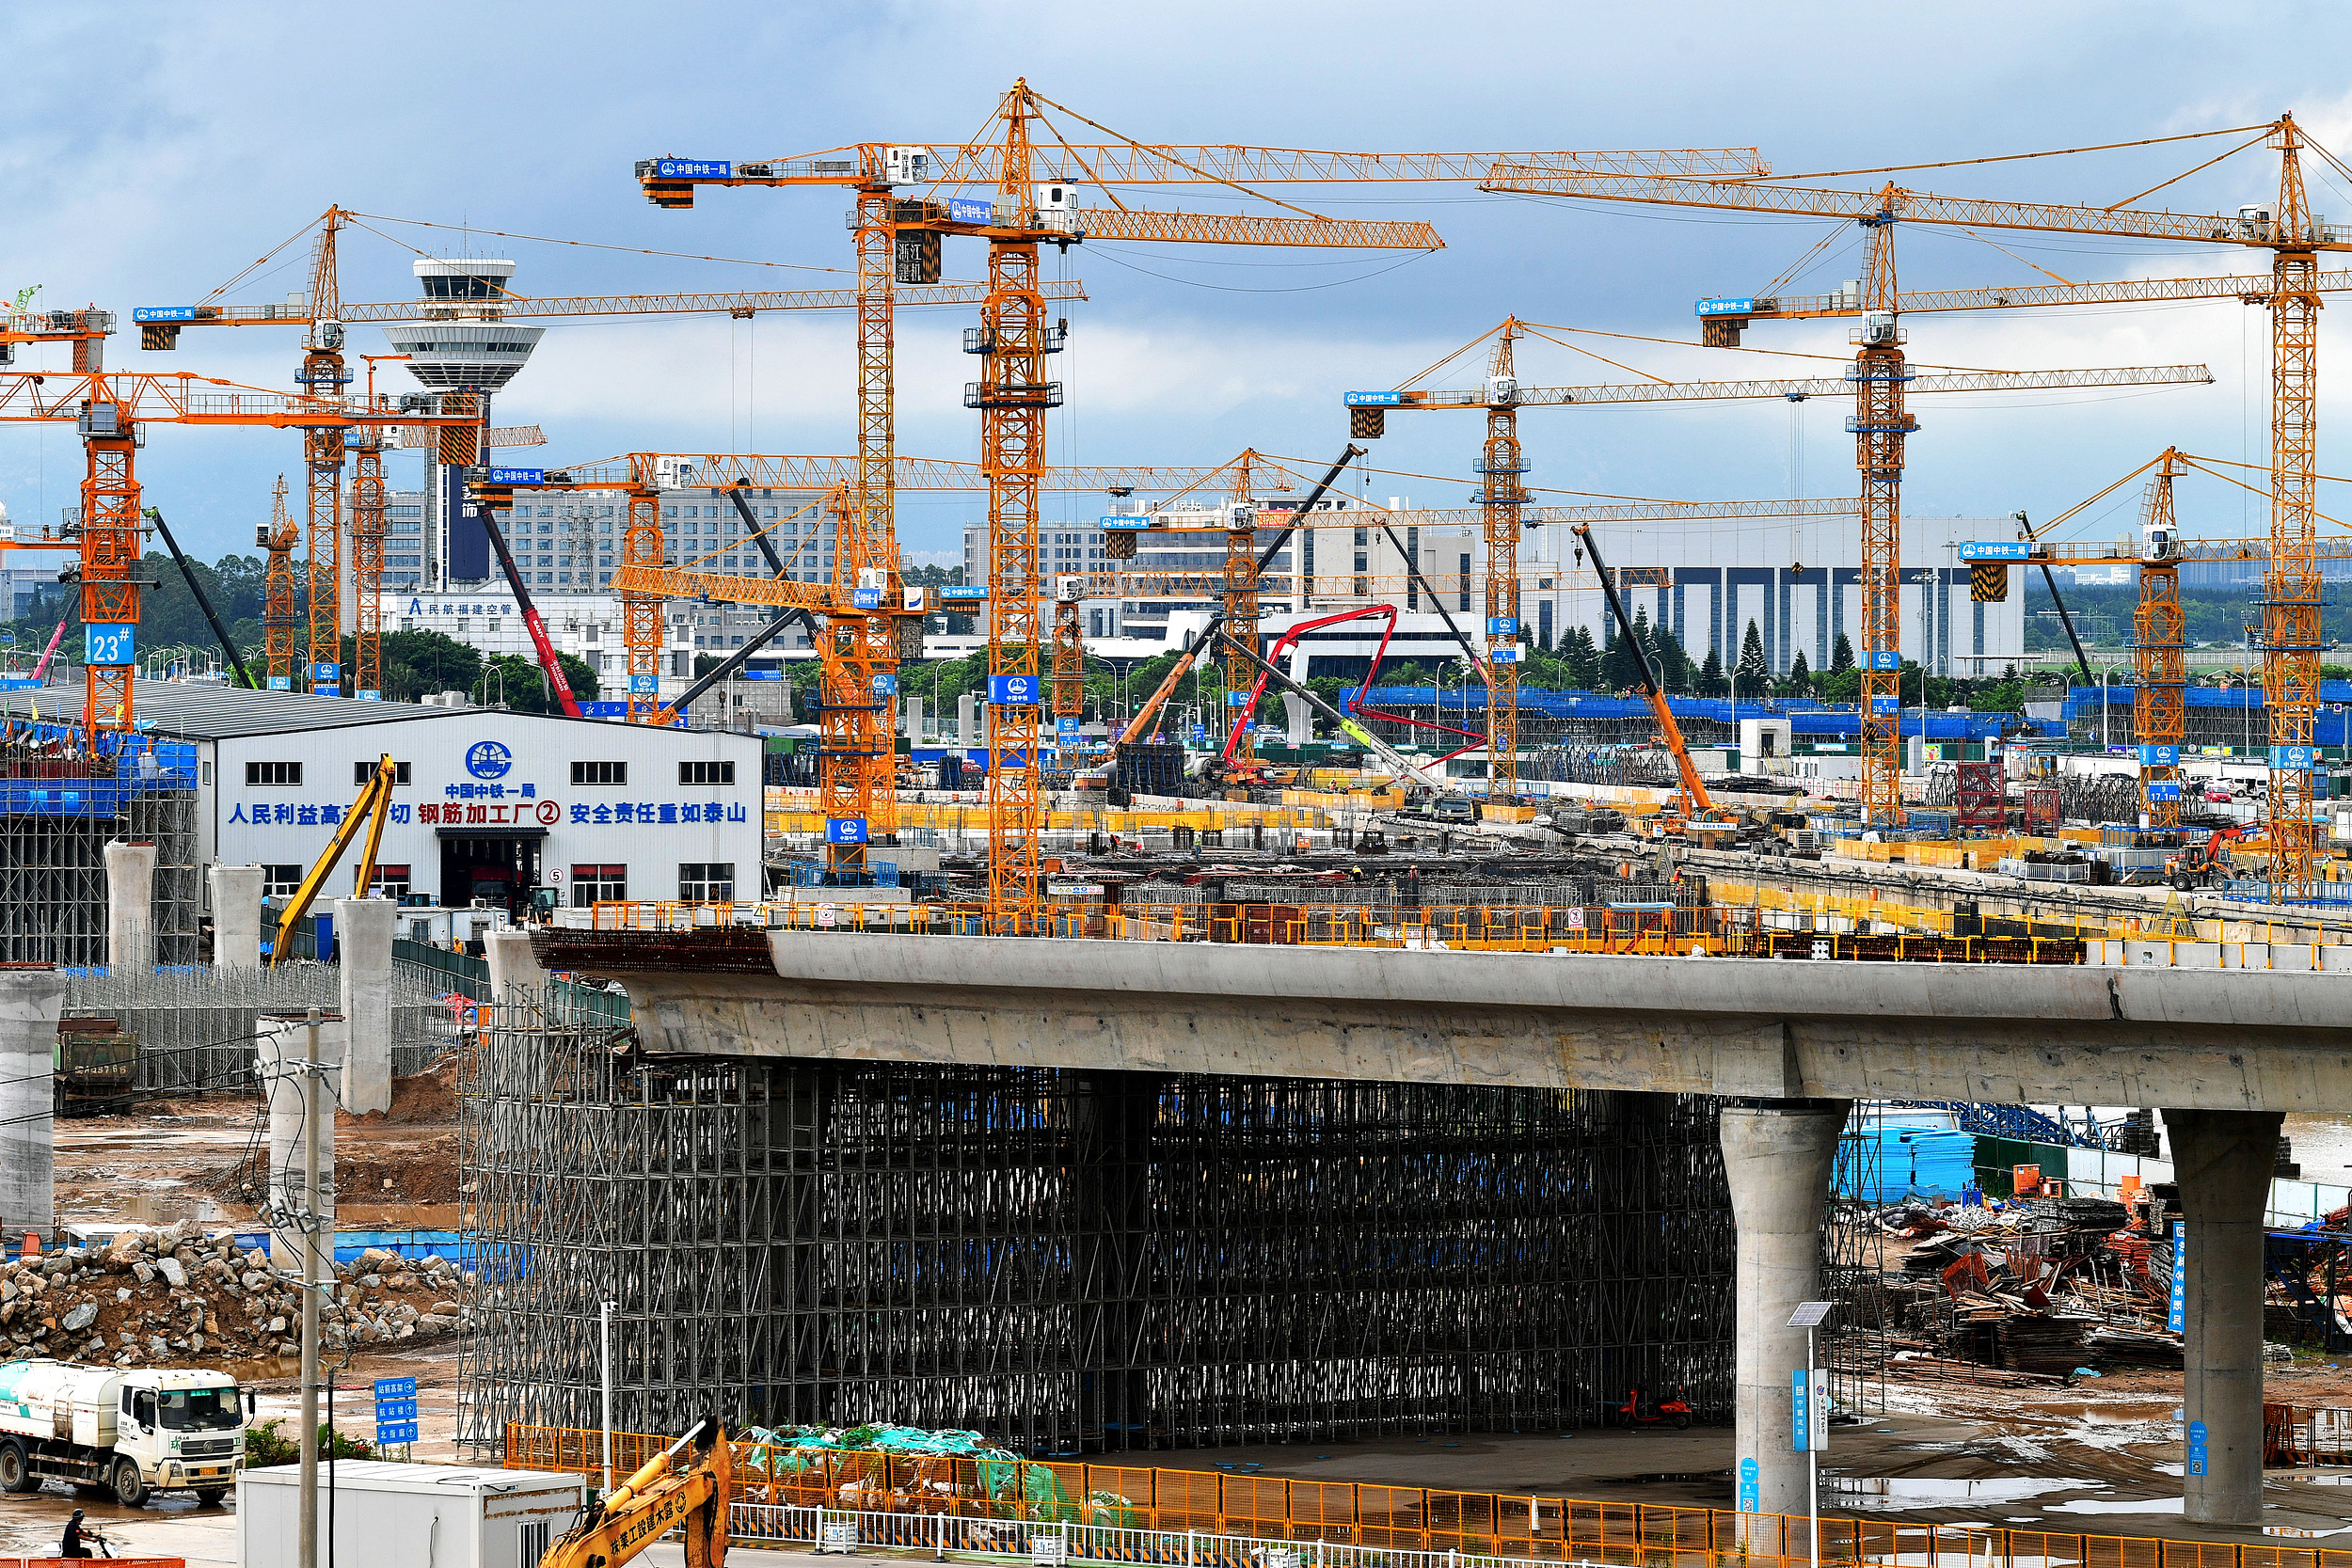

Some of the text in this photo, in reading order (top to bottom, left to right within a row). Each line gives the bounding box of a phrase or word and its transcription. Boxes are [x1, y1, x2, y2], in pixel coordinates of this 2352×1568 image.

[676, 163, 726, 176] 中国中铁一局
[961, 203, 991, 220] 中国中铁一局
[898, 243, 921, 261] 浙江
[1709, 301, 1750, 312] 中国中铁一局
[150, 309, 191, 319] 中国中铁一局
[1359, 393, 1397, 403] 中国中铁一局
[504, 471, 541, 482] 中国中铁一局
[1113, 518, 1147, 527] 中国中铁一局
[1978, 546, 2026, 555] 中国中铁一局
[951, 588, 985, 596] 中国中铁一局
[429, 604, 511, 615] 民航福建空管
[532, 619, 544, 638] SANY
[445, 783, 535, 799] 中国中铁一局
[229, 803, 411, 825] 人民利益高切
[570, 802, 746, 824] 安全责任重如泰山
[552, 871, 560, 880] 5
[378, 1384, 403, 1394] 站前高架
[379, 1406, 404, 1416] 航站楼
[381, 1429, 405, 1439] 北指廊
[171, 1437, 241, 1450] 环 卫
